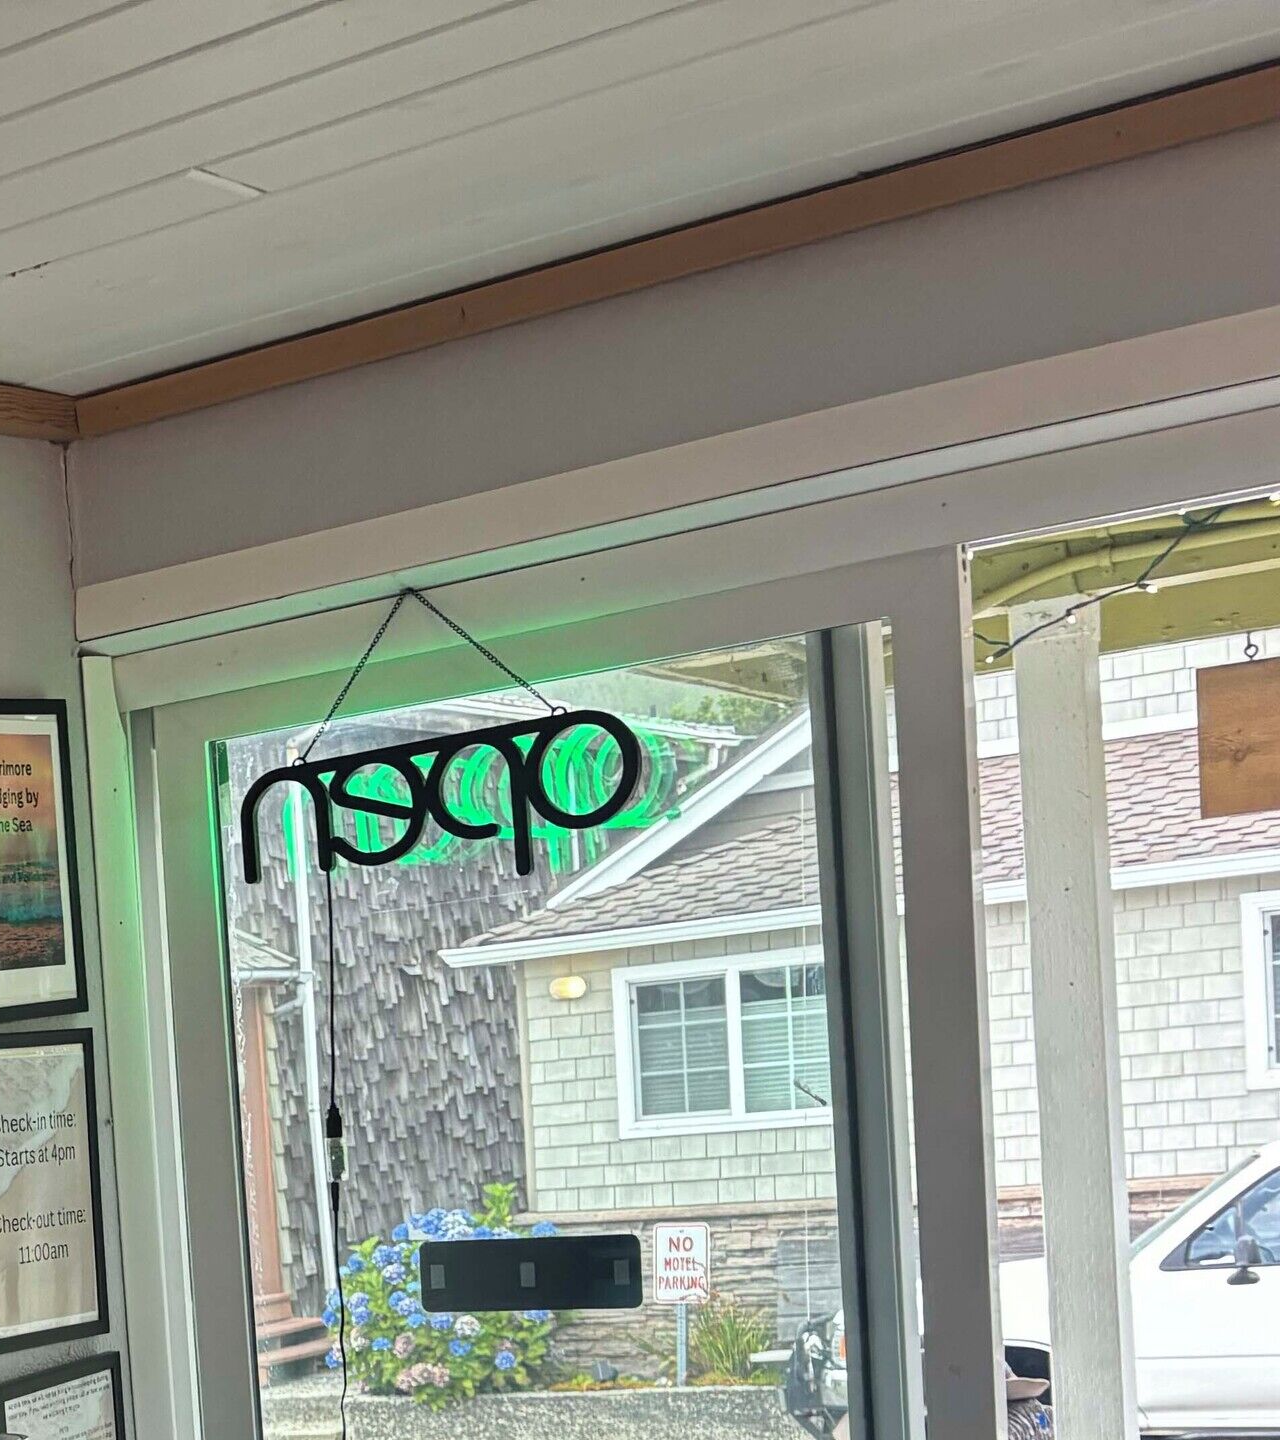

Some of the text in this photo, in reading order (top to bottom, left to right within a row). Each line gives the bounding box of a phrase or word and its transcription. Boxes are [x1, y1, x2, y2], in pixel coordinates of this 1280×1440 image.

[26, 787, 39, 807] by
[12, 817, 33, 832] Sea
[49, 1112, 77, 1129] time:
[38, 1147, 49, 1163] at
[51, 1144, 76, 1166] 4pm
[58, 1208, 87, 1227] time:
[669, 1236, 694, 1252] NO
[19, 1243, 69, 1265] 11:00am
[664, 1257, 699, 1271] MOTEL
[658, 1276, 705, 1290] PARKING
